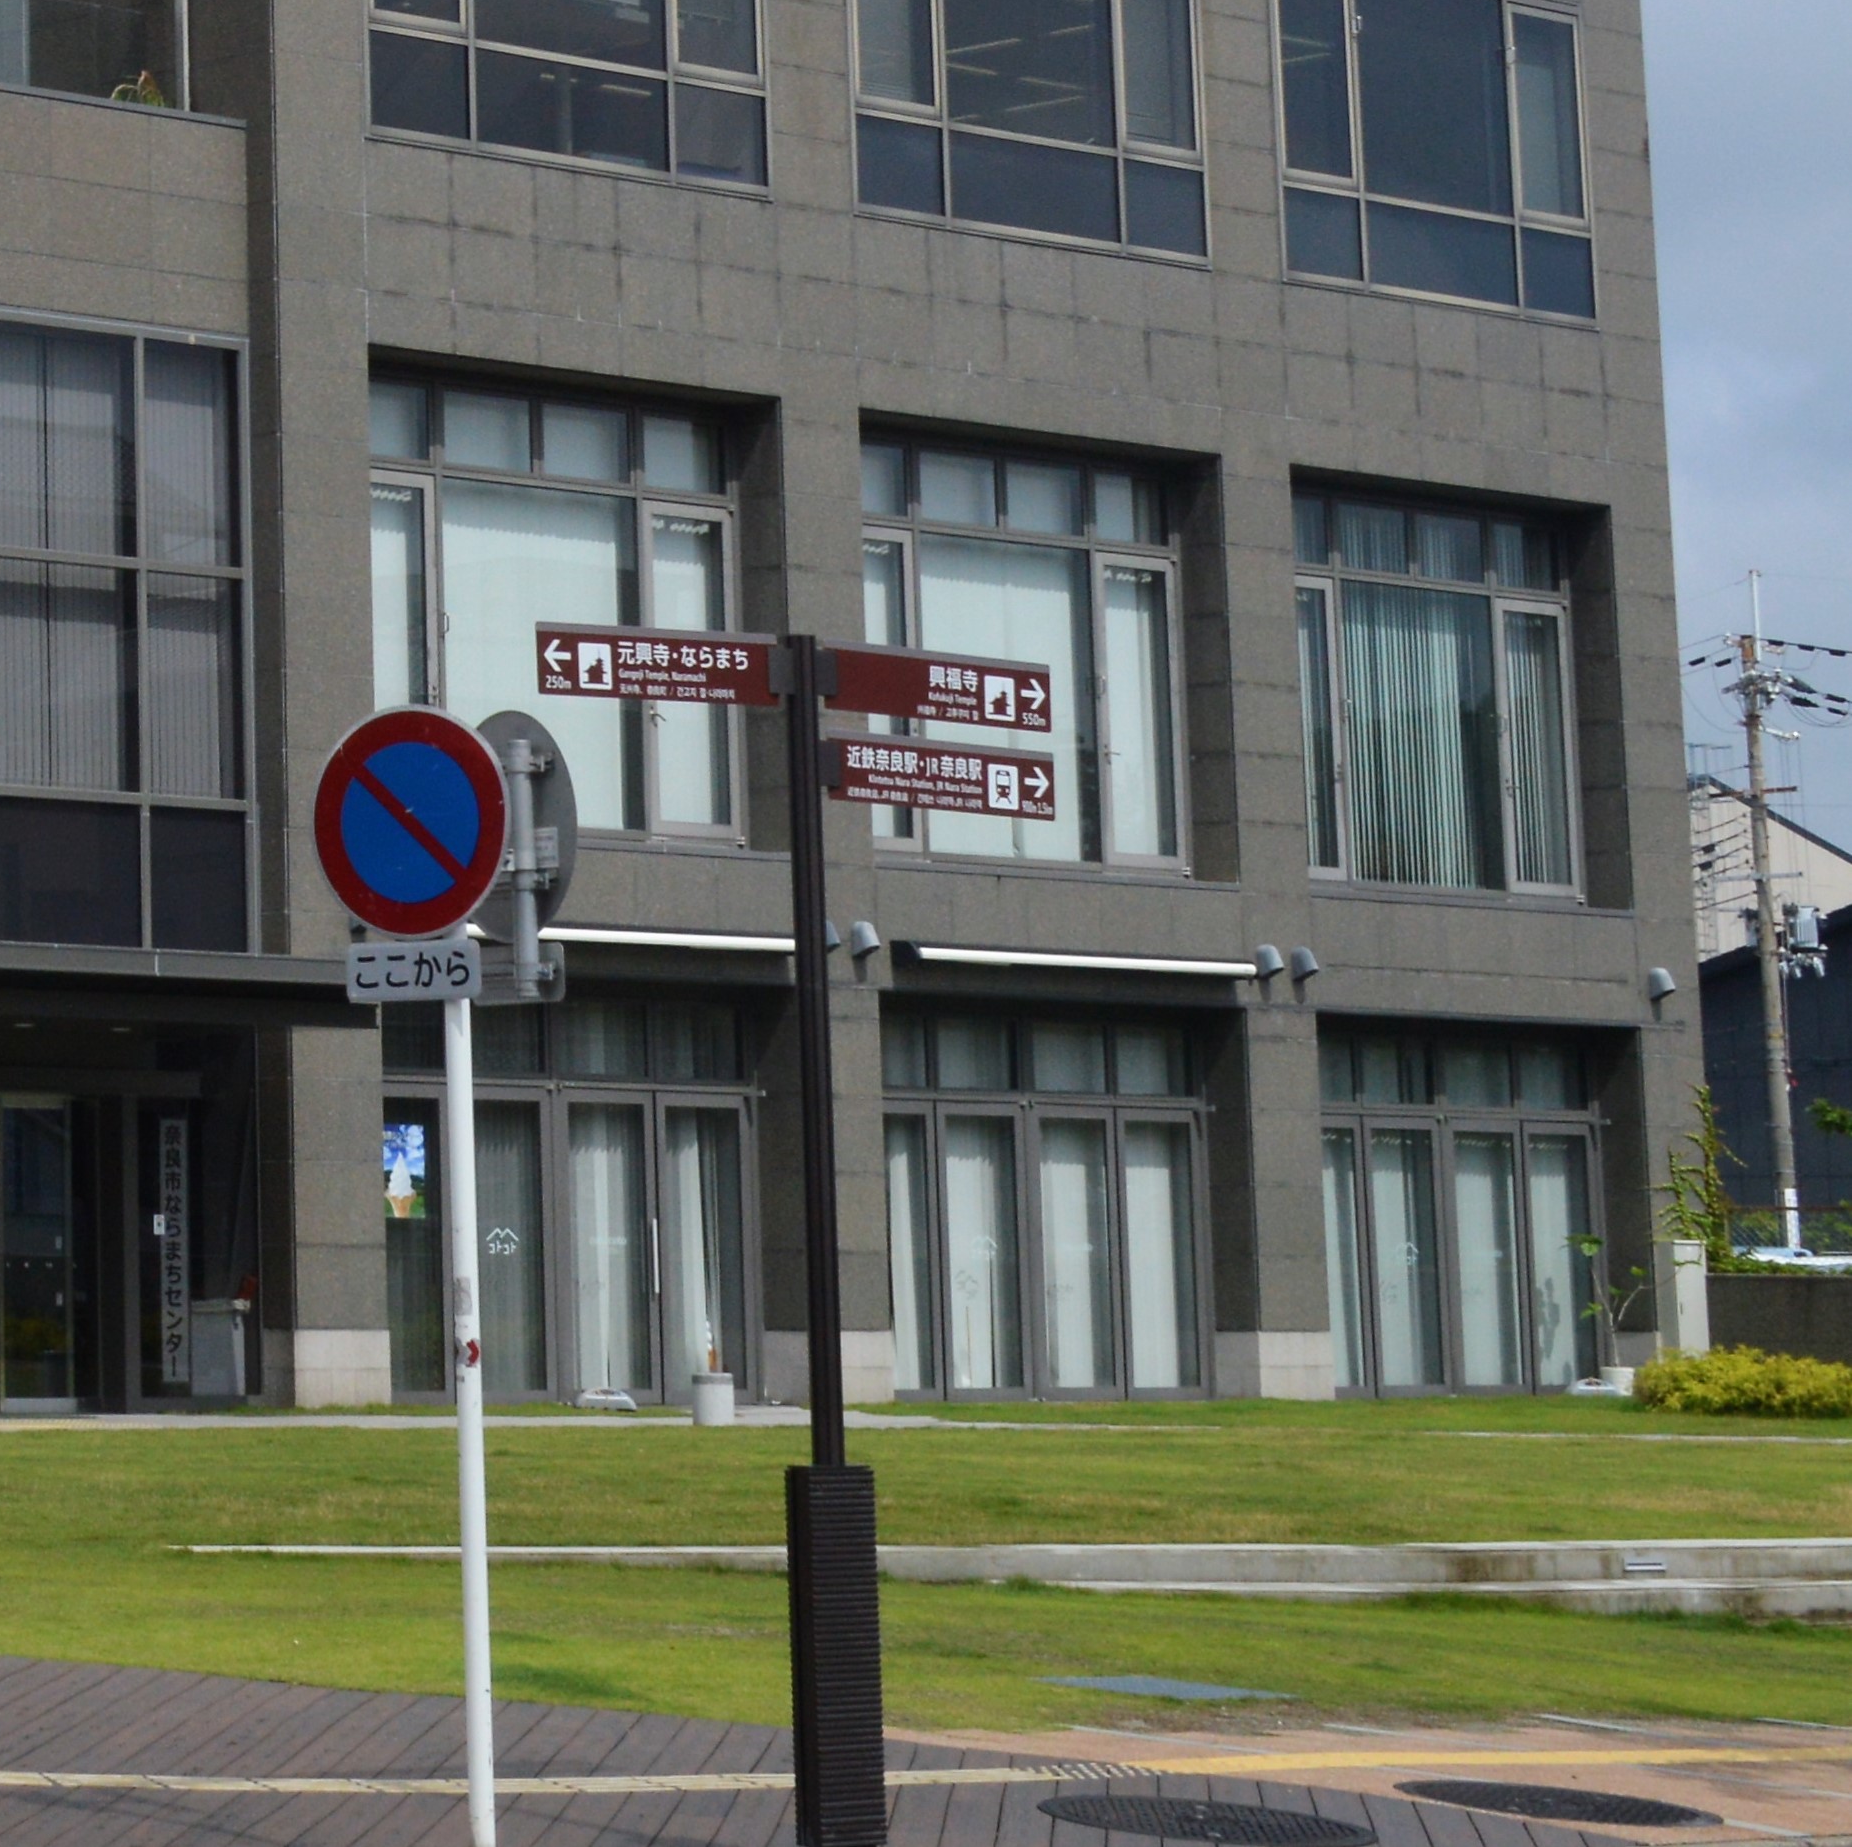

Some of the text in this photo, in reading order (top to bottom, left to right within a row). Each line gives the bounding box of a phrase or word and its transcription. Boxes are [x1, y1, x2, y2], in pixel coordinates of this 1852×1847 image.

[545, 675, 572, 689] 250m
[929, 665, 978, 692] 興福寺
[1022, 712, 1046, 726] 550m
[357, 951, 469, 988] ここから
[163, 1124, 183, 1377] 奈良市ならまちセンター
